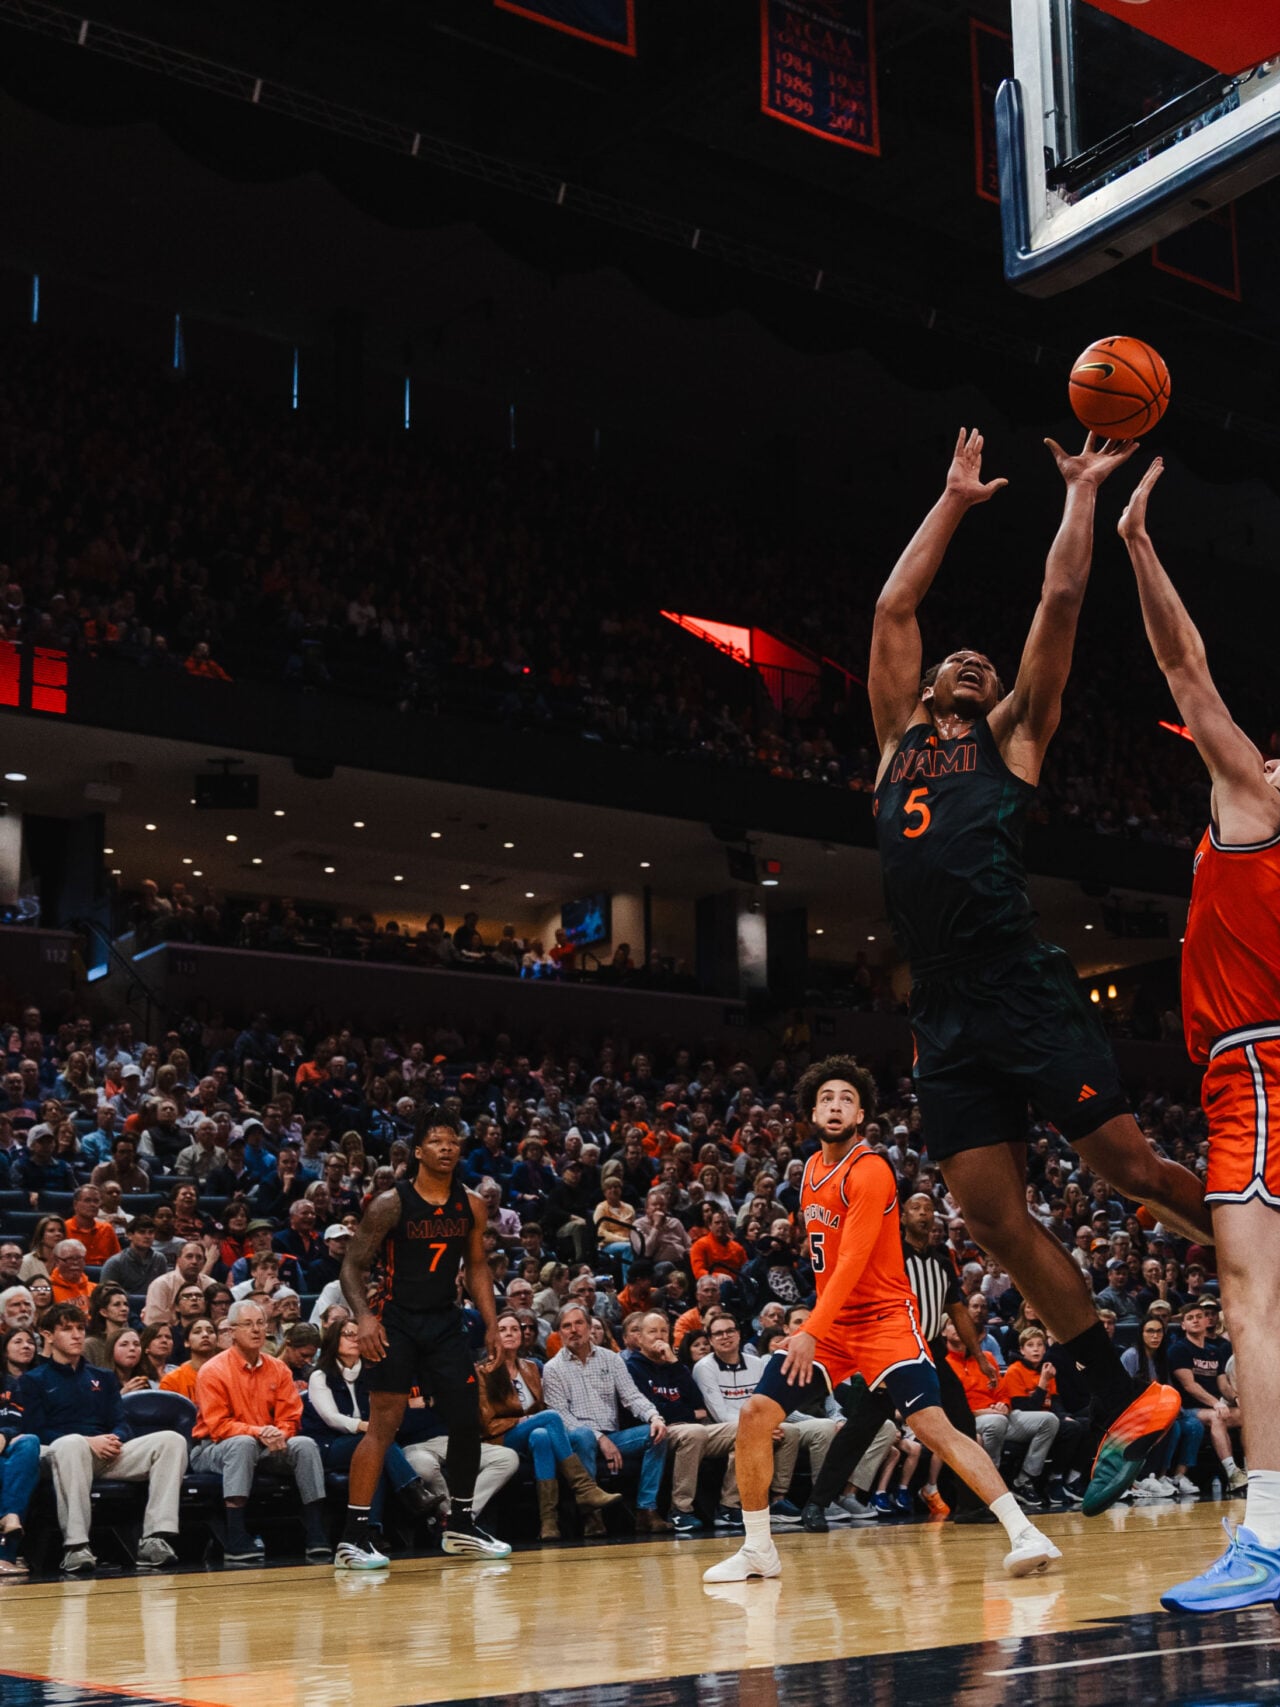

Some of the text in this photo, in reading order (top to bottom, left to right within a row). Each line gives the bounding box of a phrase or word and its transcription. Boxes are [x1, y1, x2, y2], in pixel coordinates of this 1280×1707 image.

[775, 89, 815, 117] 1999
[902, 786, 932, 839] 5
[407, 1218, 469, 1239] MIAMI
[428, 1242, 448, 1272] 7
[809, 1232, 826, 1273] 5
